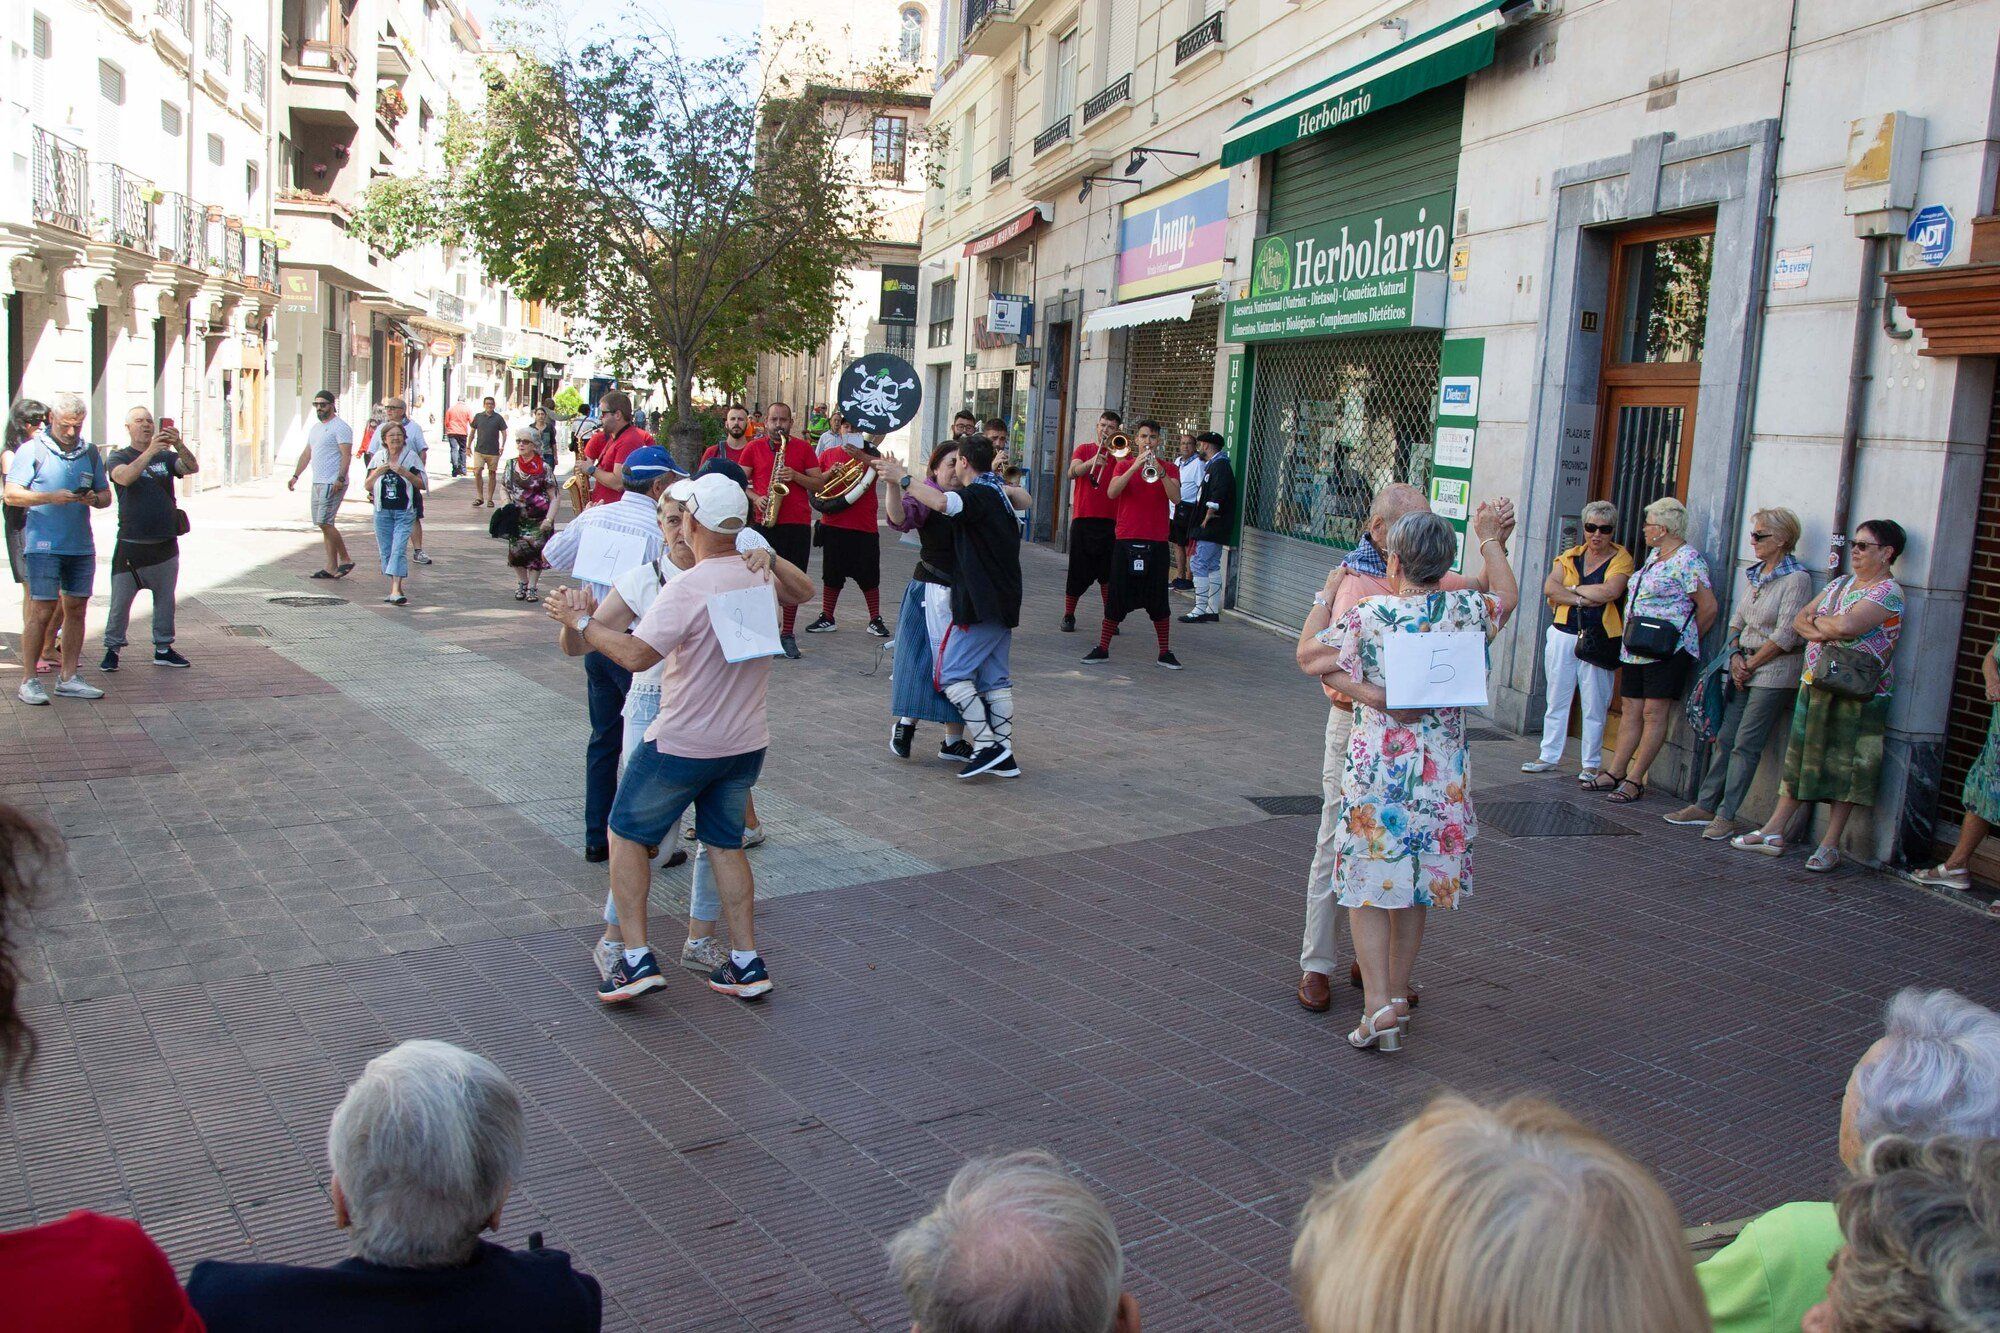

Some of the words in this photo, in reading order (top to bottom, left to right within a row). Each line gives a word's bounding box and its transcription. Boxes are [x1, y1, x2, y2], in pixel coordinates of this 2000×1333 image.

[1296, 88, 1371, 138] Herbolario
[1149, 208, 1189, 271] Anny
[1187, 215, 1196, 249] 2
[1292, 207, 1445, 290] Herbolario
[1915, 223, 1947, 247] ADT
[1788, 263, 1810, 273] EVERY
[1232, 301, 1254, 317] Asesoría
[1253, 296, 1282, 314] Nutricional
[1343, 283, 1377, 302] Cosmética
[1377, 276, 1407, 297] Natural
[1230, 323, 1256, 337] Alimentos
[1256, 318, 1281, 334] Naturales
[1281, 322, 1286, 335] y
[1286, 314, 1316, 333] Biológicos
[1319, 310, 1368, 330] Complementos
[1368, 303, 1406, 322] Dietéticos
[1584, 313, 1596, 329] 11
[1227, 360, 1239, 458] Herbo
[1565, 428, 1583, 438] PLAZA
[1583, 429, 1591, 439] DE
[1572, 445, 1580, 455] LA
[1561, 459, 1588, 471] PROVINCIA
[603, 543, 621, 582] 4
[1429, 648, 1456, 684] 5
